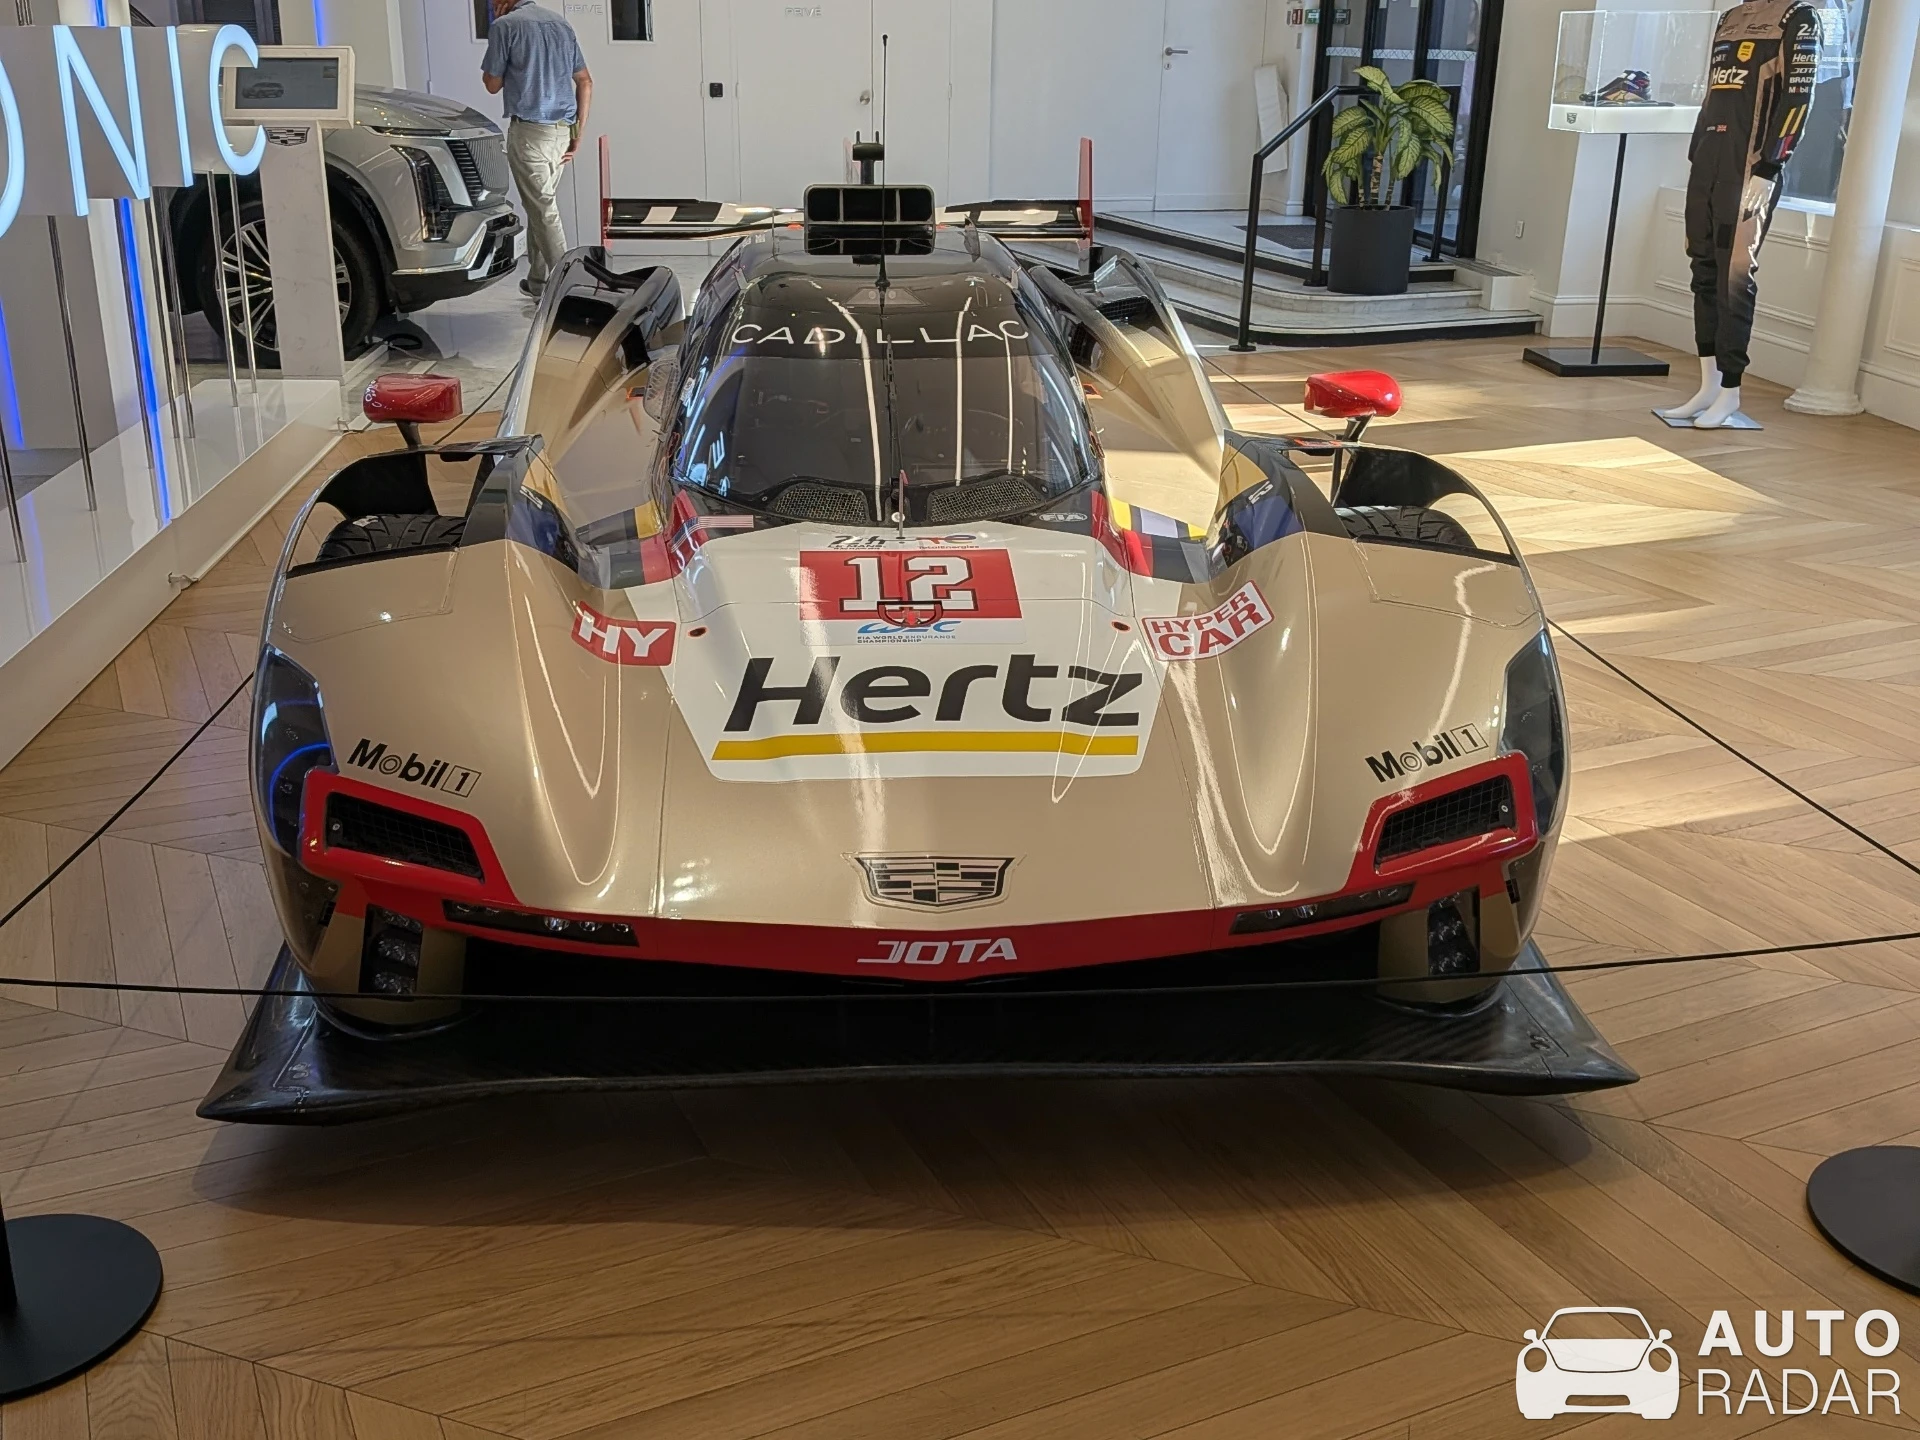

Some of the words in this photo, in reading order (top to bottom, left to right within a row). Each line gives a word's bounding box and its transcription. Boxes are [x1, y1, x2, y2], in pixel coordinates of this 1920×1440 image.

[1711, 66, 1749, 84] Hertz
[731, 320, 1029, 345] CADILLAC
[840, 556, 978, 612] 12
[578, 610, 669, 657] HY
[1152, 591, 1250, 633] HYPER
[1158, 602, 1264, 656] CAR
[723, 654, 1143, 732] Hertz
[347, 738, 450, 789] Mobil
[1364, 732, 1462, 783] Mobil
[857, 937, 1018, 965] JOTA
